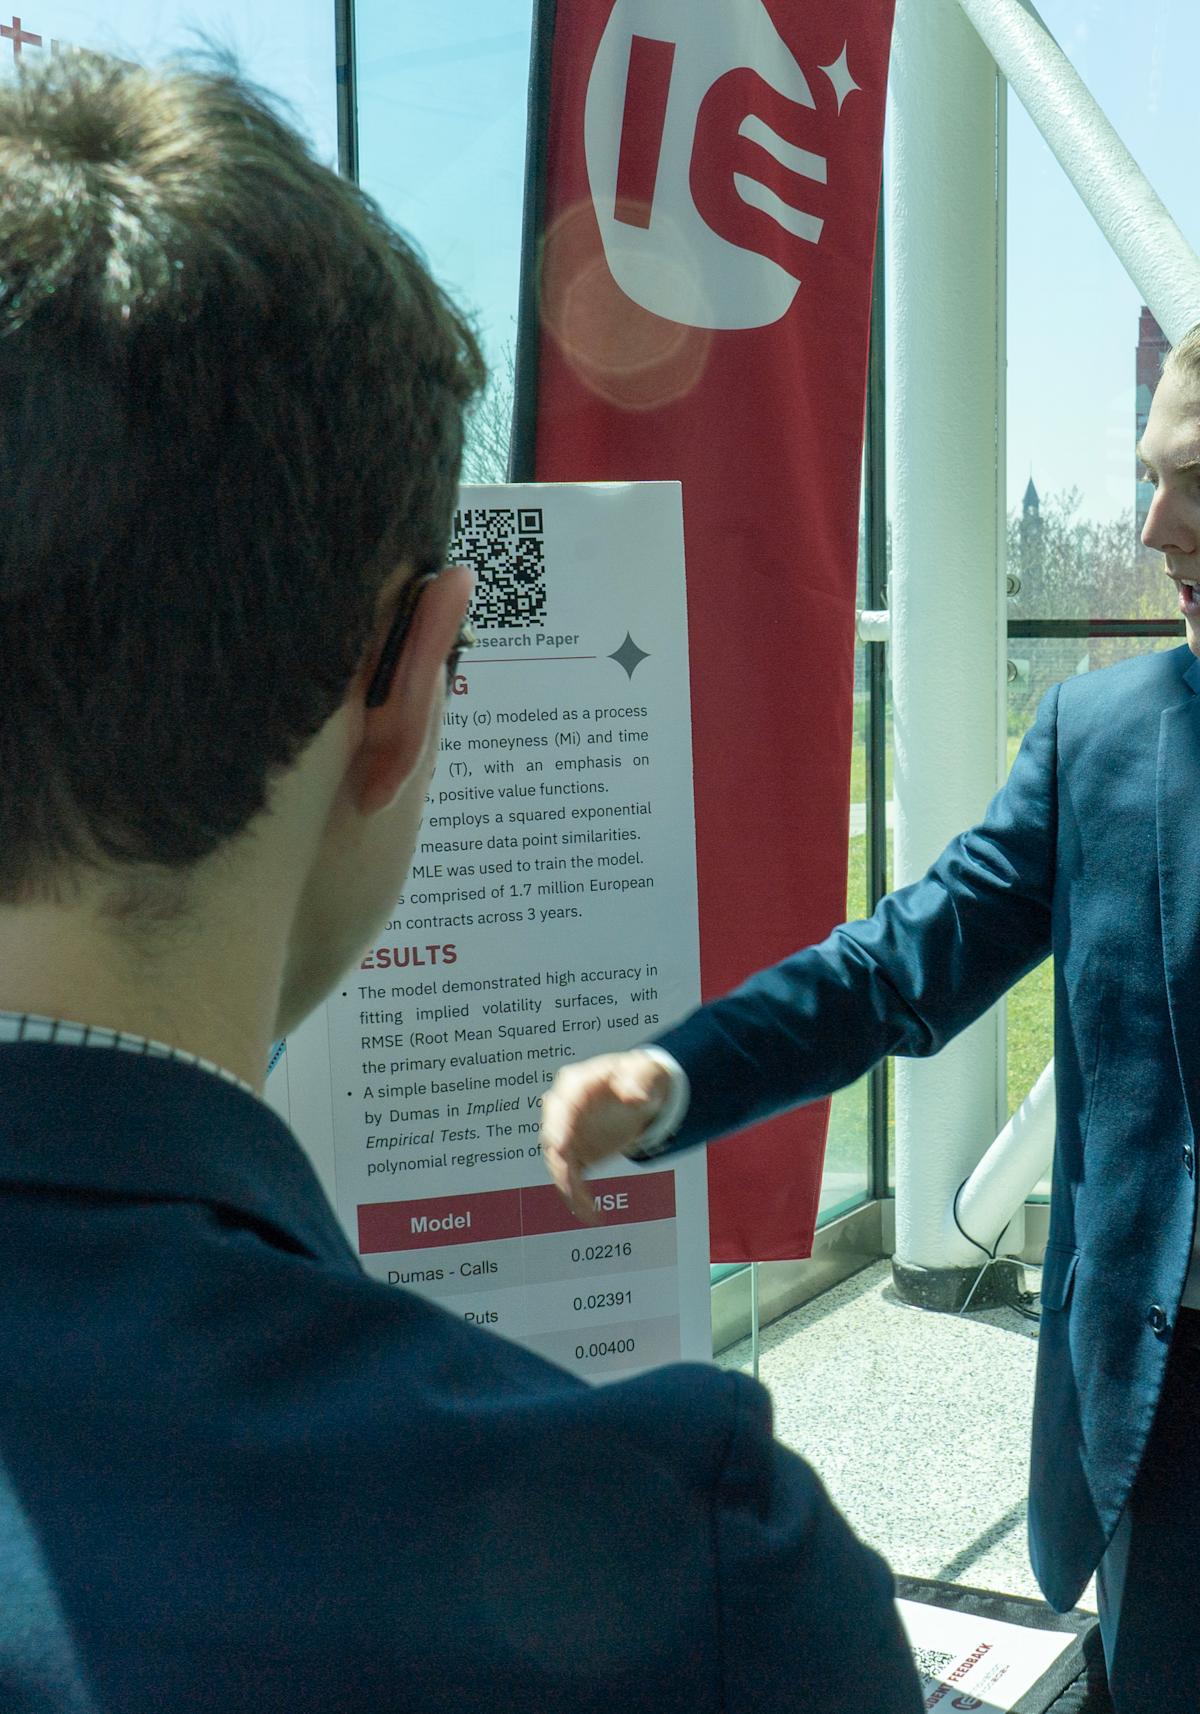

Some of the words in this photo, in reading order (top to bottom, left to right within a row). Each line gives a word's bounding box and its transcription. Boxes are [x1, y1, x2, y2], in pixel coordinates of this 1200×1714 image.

[474, 633, 532, 648] esearch
[536, 634, 579, 648] Paper
[443, 711, 469, 728] ility
[497, 707, 558, 723] modeled
[563, 710, 578, 720] as
[582, 710, 591, 719] a
[595, 707, 647, 722] process
[438, 737, 462, 752] ike
[468, 737, 548, 751] moneyness
[555, 731, 580, 748] (Mi)
[587, 730, 612, 744] and
[618, 729, 648, 742] time
[449, 762, 472, 778] (T),
[484, 760, 514, 774] with
[526, 762, 543, 772] an
[555, 755, 621, 772] emphasis
[633, 756, 649, 766] on
[439, 786, 494, 804] positive
[498, 784, 536, 798] value
[539, 781, 608, 796] functions.
[430, 812, 490, 829] employs
[495, 814, 503, 823] a
[509, 806, 566, 824] squared
[571, 801, 652, 821] exponential
[421, 840, 483, 853] measure
[487, 835, 518, 849] data
[522, 833, 558, 850] point
[562, 828, 640, 844] similarities.
[413, 865, 443, 879] MLE
[446, 866, 475, 876] was
[479, 859, 512, 874] used
[516, 860, 531, 871] to
[534, 857, 566, 870] train
[570, 856, 593, 868] the
[598, 851, 643, 867] model.
[410, 886, 486, 905] comprised
[491, 885, 504, 898] of
[510, 883, 532, 897] 1.7
[538, 881, 584, 895] million
[590, 878, 653, 892] European
[406, 914, 473, 929] contracts
[478, 912, 523, 924] across
[528, 908, 535, 920] 3
[540, 908, 582, 923] years.
[360, 943, 458, 970] ESULTS
[358, 986, 386, 999] The
[392, 981, 437, 997] model
[442, 972, 541, 993] demonstrated
[546, 970, 575, 987] high
[581, 968, 641, 982] accuracy
[646, 964, 657, 976] in
[360, 1010, 403, 1025] fitting
[416, 1003, 469, 1022] implied
[482, 998, 542, 1015] volatility
[555, 994, 617, 1008] surfaces,
[631, 987, 657, 1002] with
[362, 1034, 403, 1049] RMSE
[410, 1032, 448, 1047] (Root
[455, 1029, 492, 1042] Mean
[498, 1020, 556, 1039] Squared
[562, 1016, 601, 1032] Error)
[608, 1013, 639, 1028] used
[644, 1014, 659, 1024] as
[362, 1061, 386, 1074] the
[390, 1058, 446, 1075] primary
[450, 1049, 522, 1067] evaluation
[527, 1044, 575, 1059] metric.
[363, 1086, 374, 1099] A
[378, 1082, 427, 1099] simple
[431, 1077, 490, 1093] baseline
[495, 1070, 538, 1087] model
[542, 1070, 553, 1082] is
[365, 1111, 382, 1126] by
[390, 1109, 440, 1122] Dumas
[447, 1104, 459, 1117] in
[466, 1097, 520, 1116] Implied
[527, 1095, 543, 1109] Vo
[366, 1130, 434, 1150] Empirical
[440, 1128, 480, 1142] Tests.
[486, 1124, 512, 1137] The
[518, 1120, 542, 1134] mo
[368, 1153, 447, 1176] polynomial
[452, 1147, 524, 1167] regression
[528, 1144, 542, 1160] of
[591, 1193, 629, 1213] MSE
[410, 1211, 472, 1234] Model
[571, 1242, 631, 1262] 0.02216
[388, 1269, 444, 1284] Dumas
[460, 1260, 498, 1276] Calls
[573, 1290, 631, 1311] 0.02391
[464, 1311, 499, 1325] Puts
[575, 1338, 635, 1359] 0.00400
[947, 1642, 994, 1682] FEEDBACK
